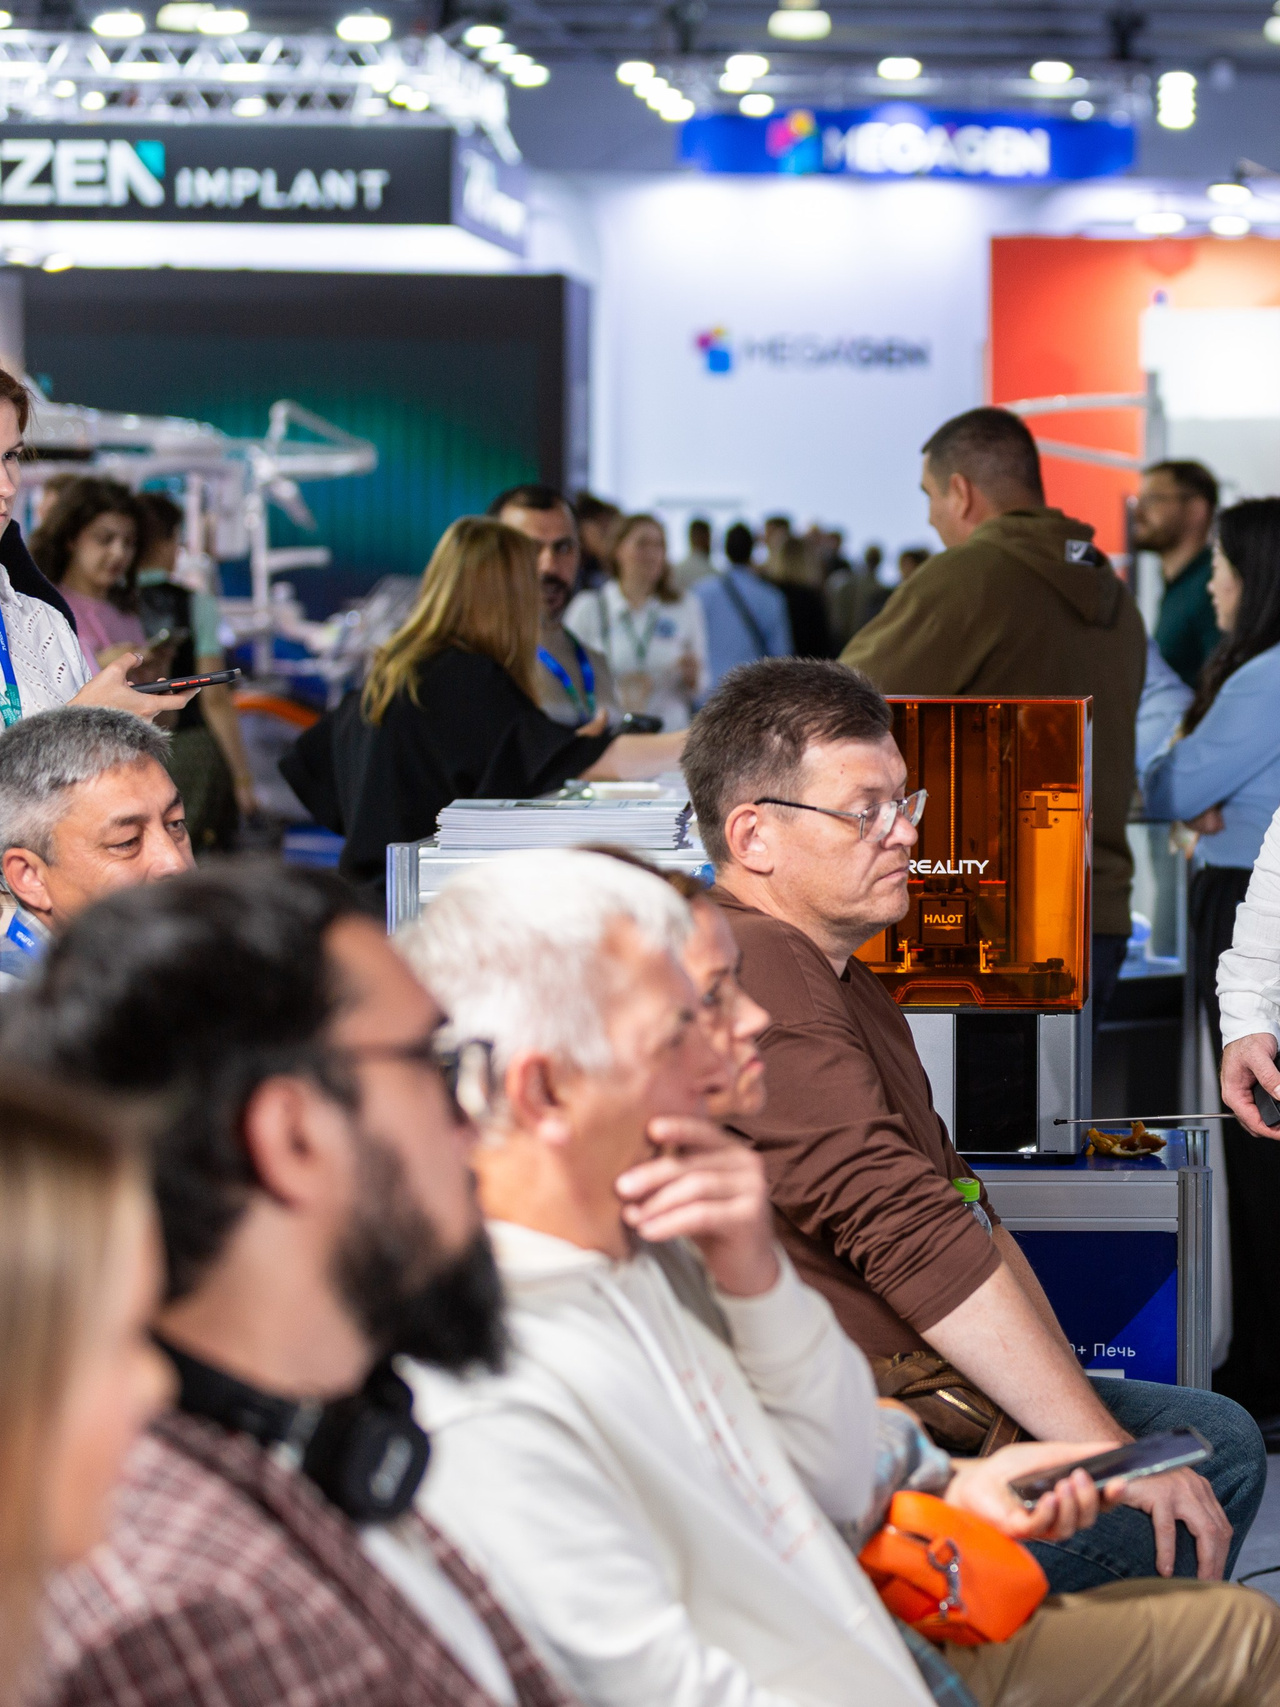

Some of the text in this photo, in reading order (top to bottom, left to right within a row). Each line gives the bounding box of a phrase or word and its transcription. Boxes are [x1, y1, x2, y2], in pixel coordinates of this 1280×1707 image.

[0, 138, 390, 210] ZEN IMPLANT
[908, 859, 990, 875] REALITY
[923, 914, 964, 924] HALOT
[1093, 1343, 1136, 1357] Печь
